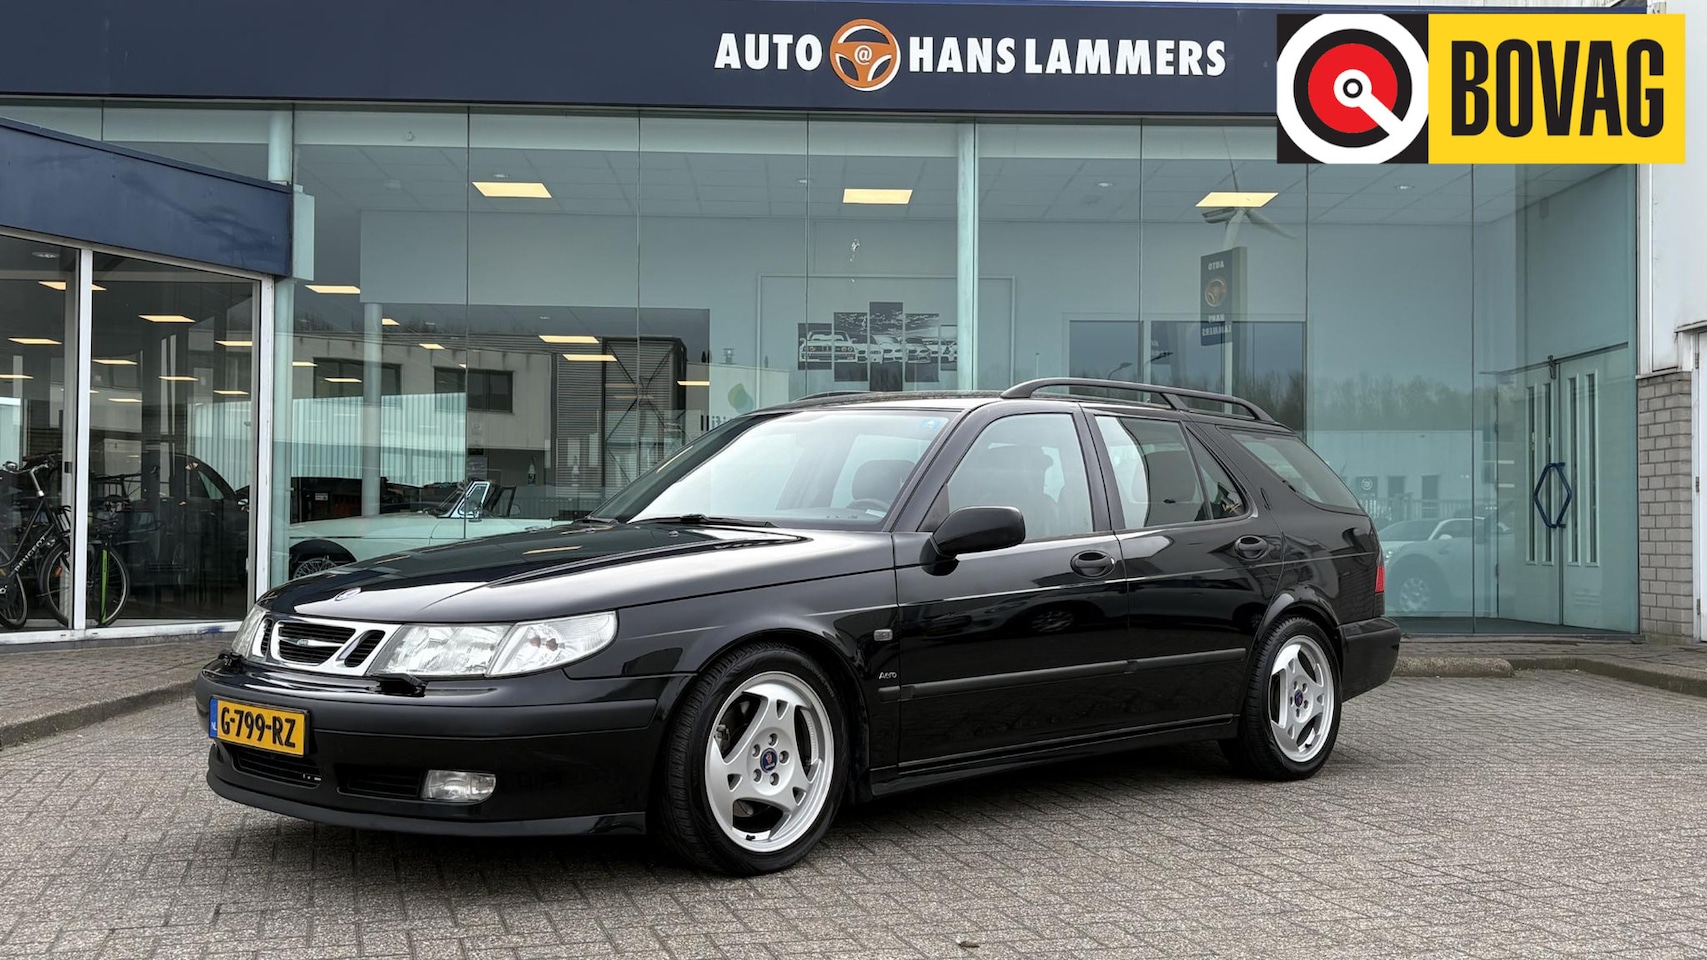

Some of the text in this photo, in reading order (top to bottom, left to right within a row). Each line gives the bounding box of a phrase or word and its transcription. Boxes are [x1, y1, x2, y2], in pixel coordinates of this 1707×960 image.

[714, 33, 823, 71] AUTO
[908, 36, 1016, 74] HANS
[1025, 38, 1227, 77] LAMMERS
[14, 535, 46, 572] PEUGEOT
[221, 706, 296, 749] G-799-RZ
